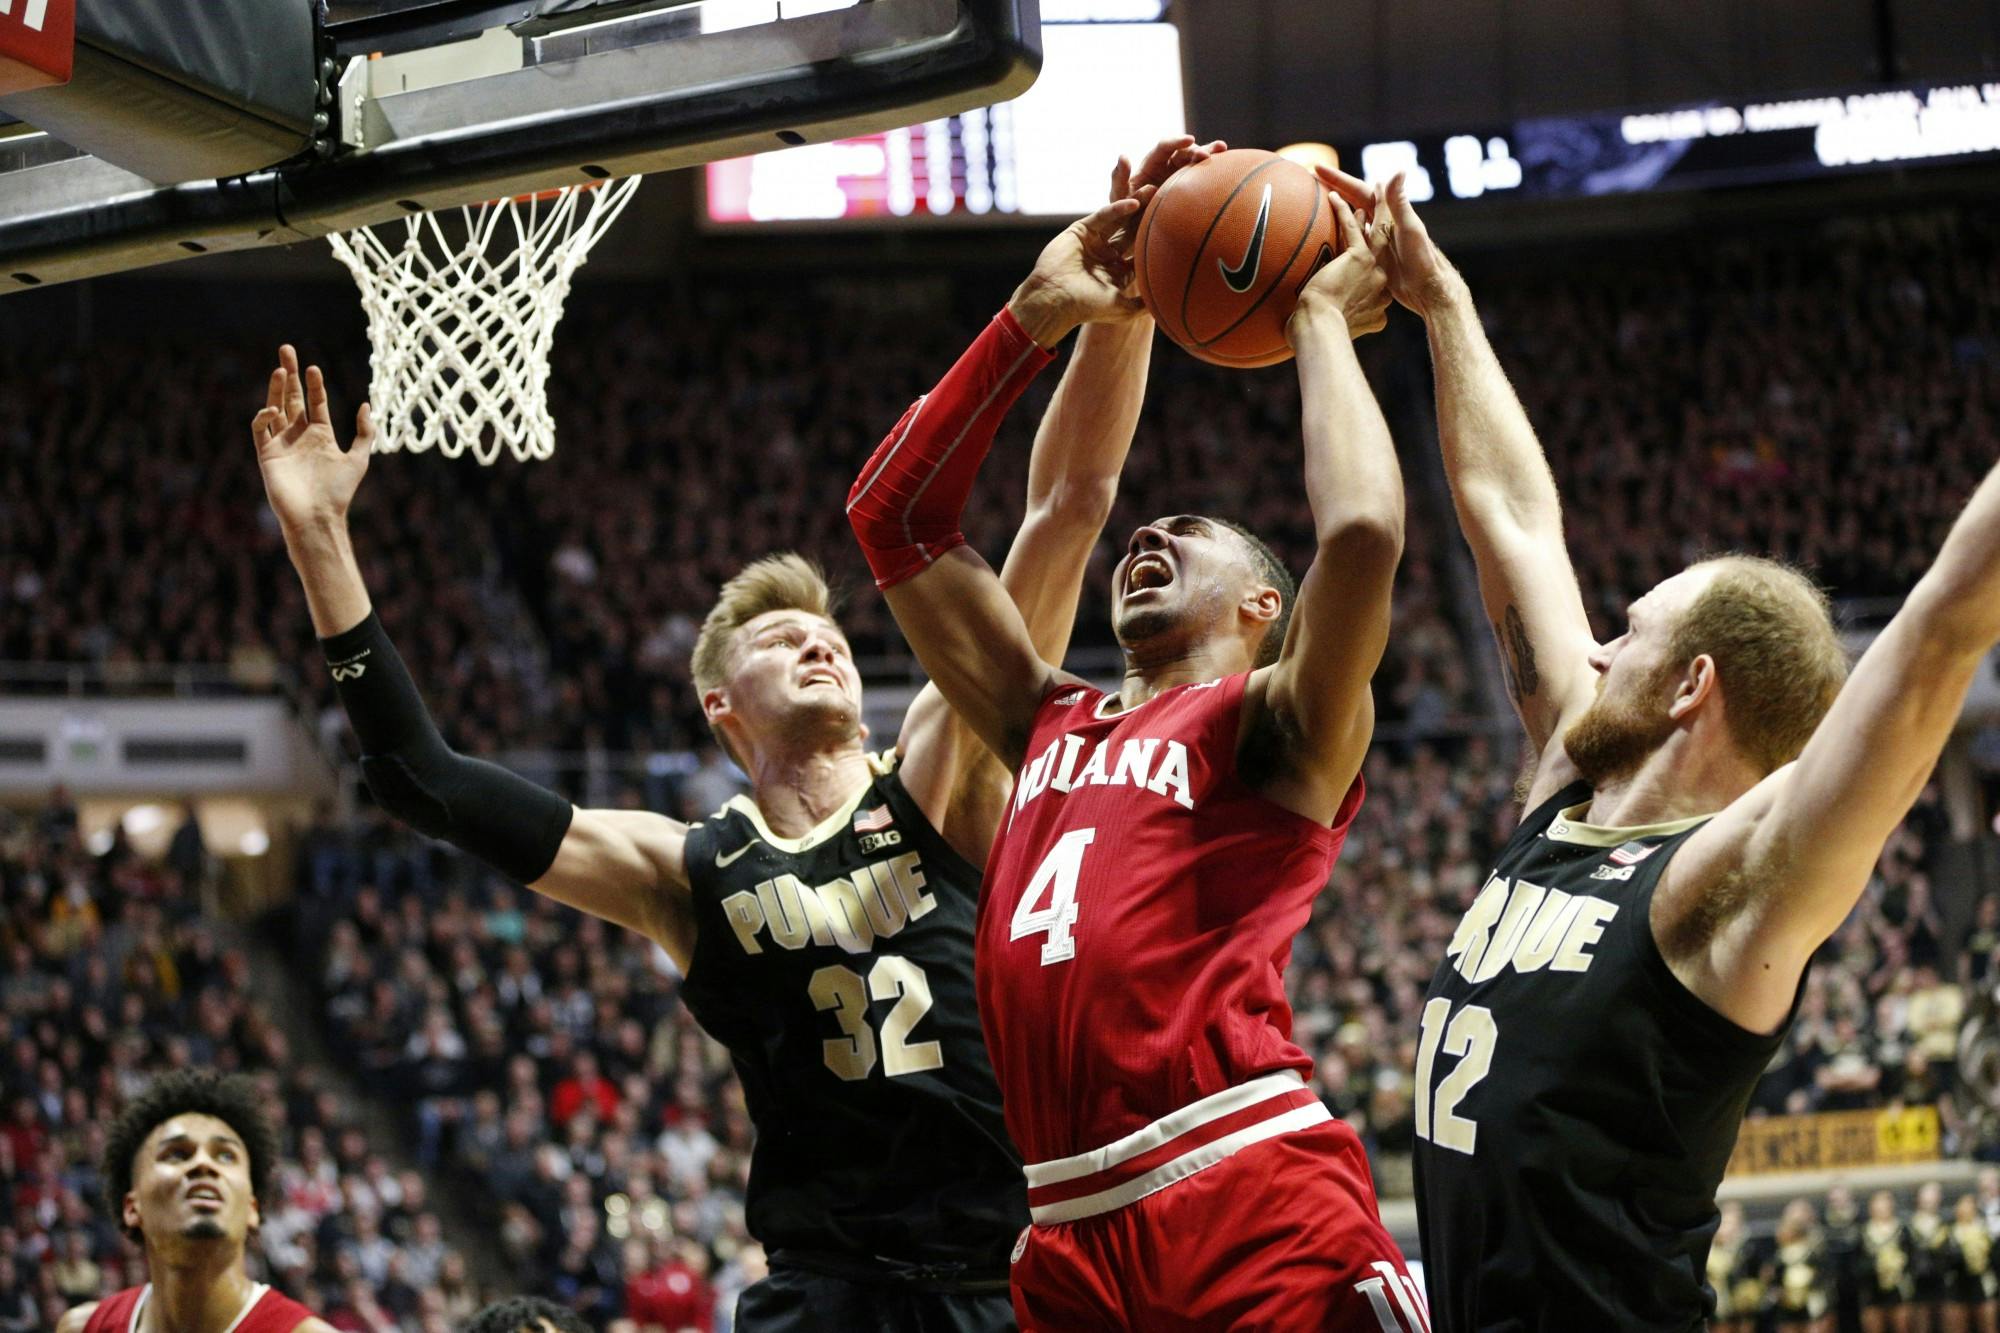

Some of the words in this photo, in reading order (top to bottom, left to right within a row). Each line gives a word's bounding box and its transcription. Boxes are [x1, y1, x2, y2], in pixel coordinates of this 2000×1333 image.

[1007, 733, 1194, 834] NDIANA
[1010, 827, 1096, 967] 4
[807, 956, 944, 1081] 32
[1414, 997, 1498, 1155] 12
